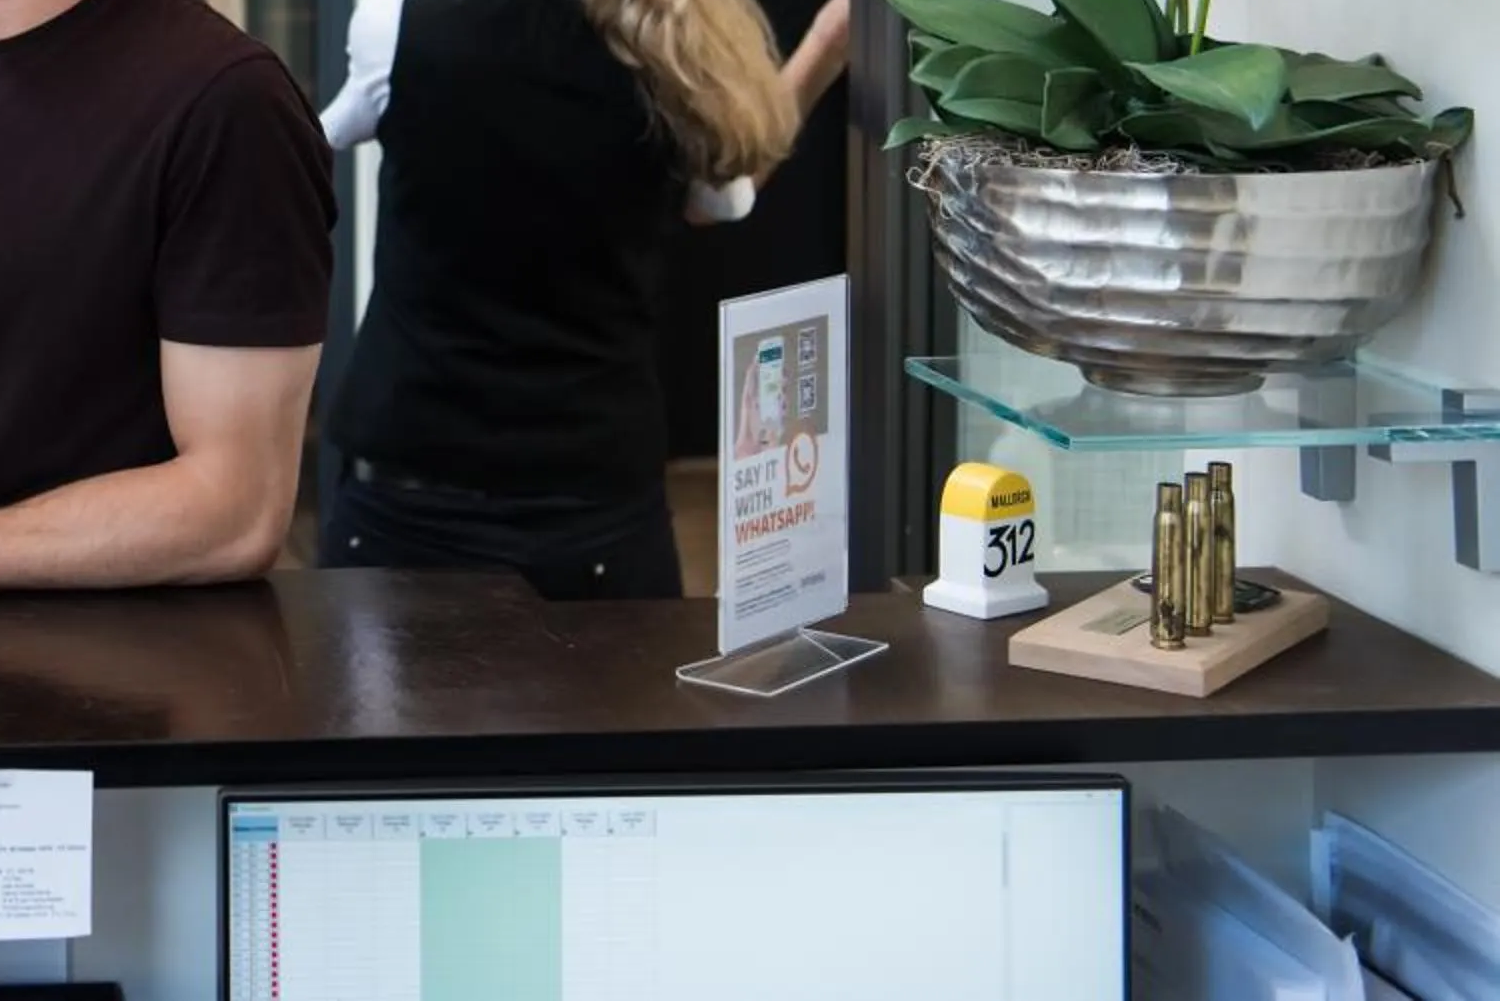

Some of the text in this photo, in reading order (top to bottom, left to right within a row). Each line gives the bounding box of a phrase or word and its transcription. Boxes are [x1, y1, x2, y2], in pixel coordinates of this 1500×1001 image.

[735, 459, 778, 491] SAY IT
[735, 487, 773, 517] WITH
[735, 501, 816, 545] WHATSAPP!
[983, 519, 1035, 578] 312
